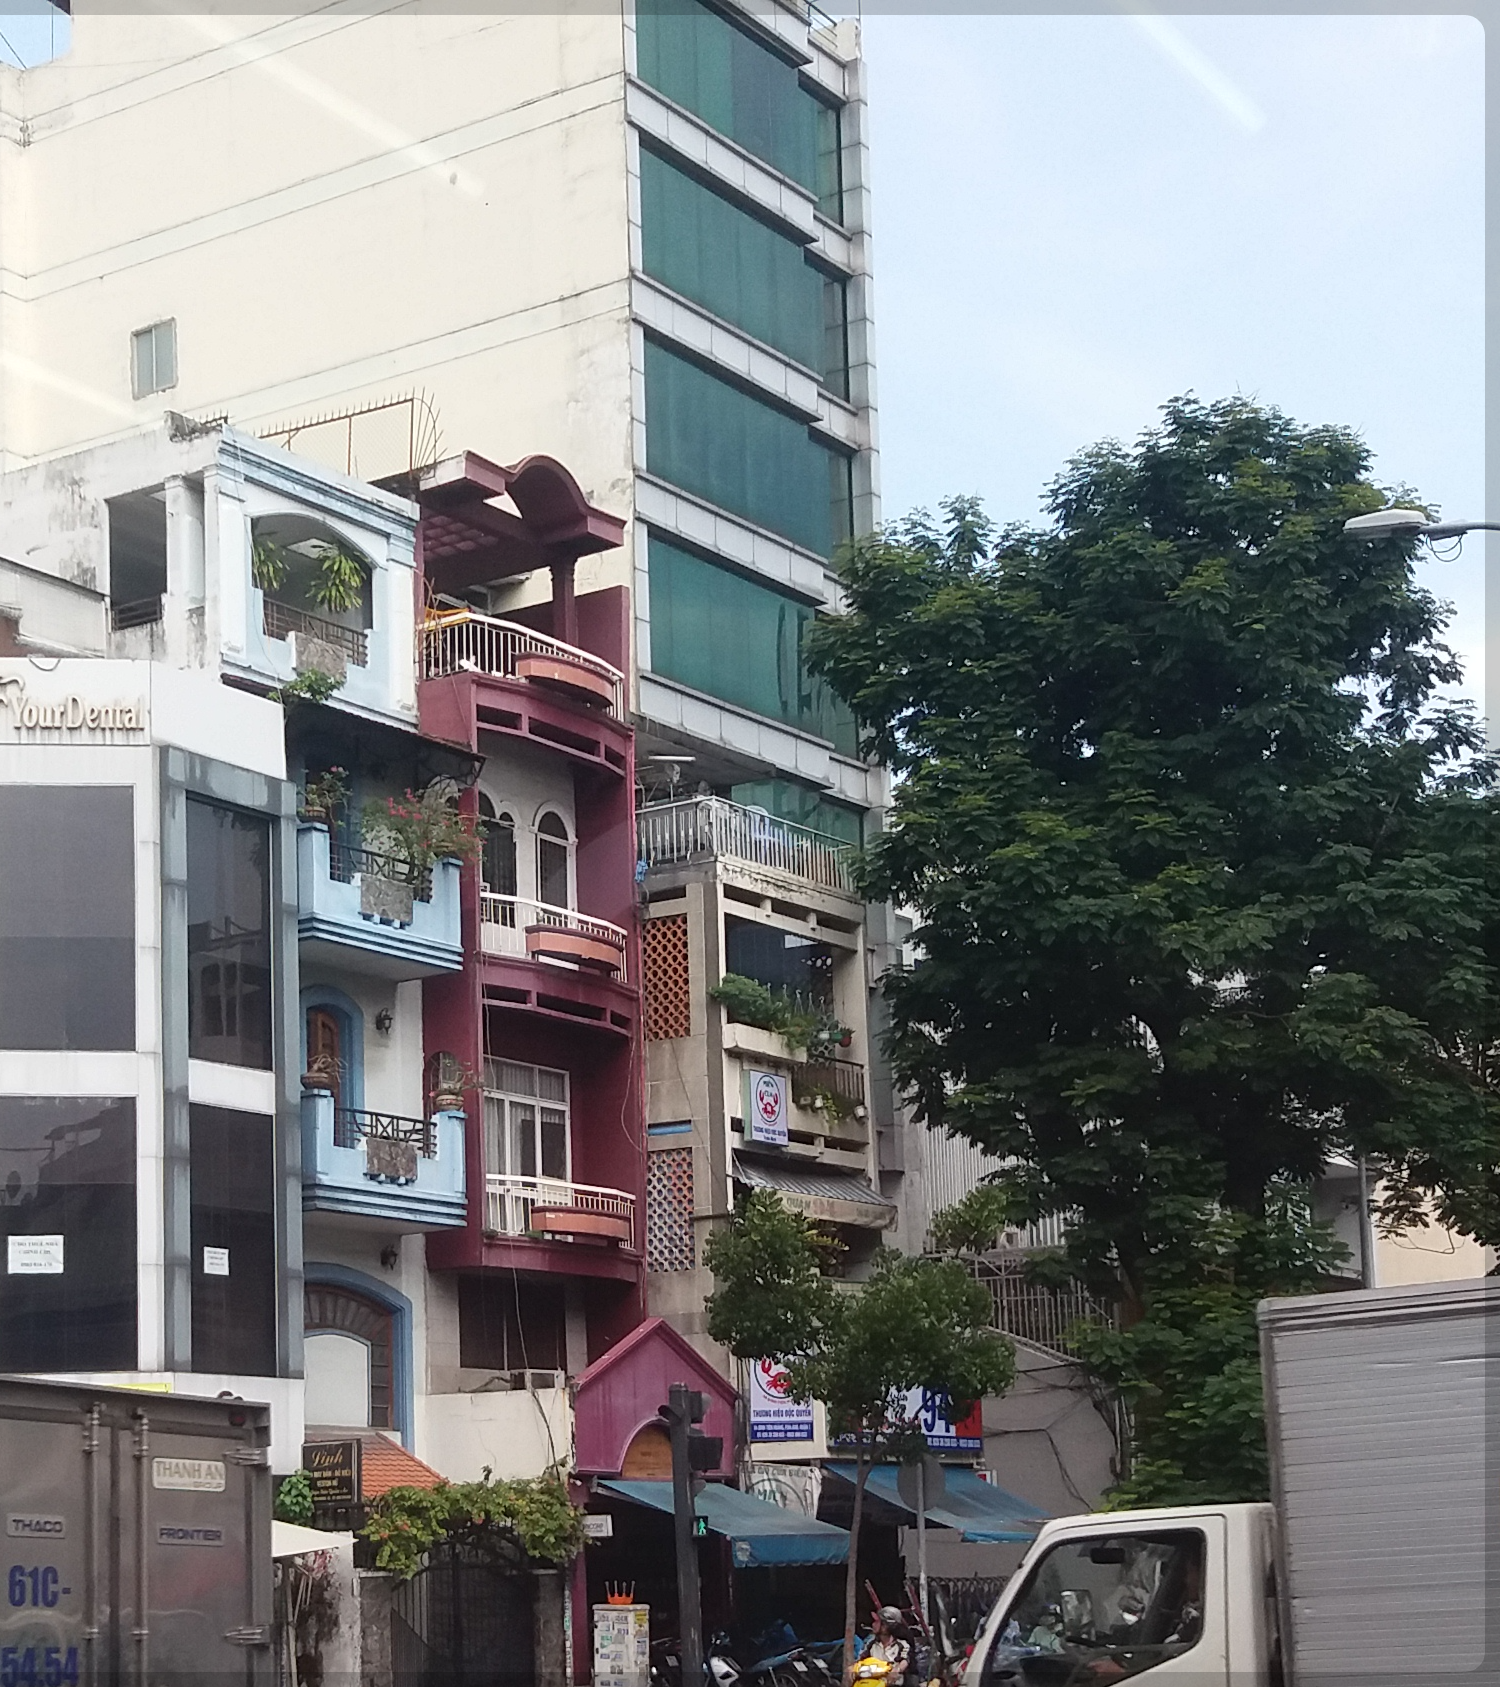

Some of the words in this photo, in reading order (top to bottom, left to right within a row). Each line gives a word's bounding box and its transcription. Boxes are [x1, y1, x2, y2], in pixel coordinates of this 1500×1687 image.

[155, 1461, 202, 1478] THANH
[12, 1518, 63, 1533] THACO
[160, 1527, 221, 1541] FRONTIER
